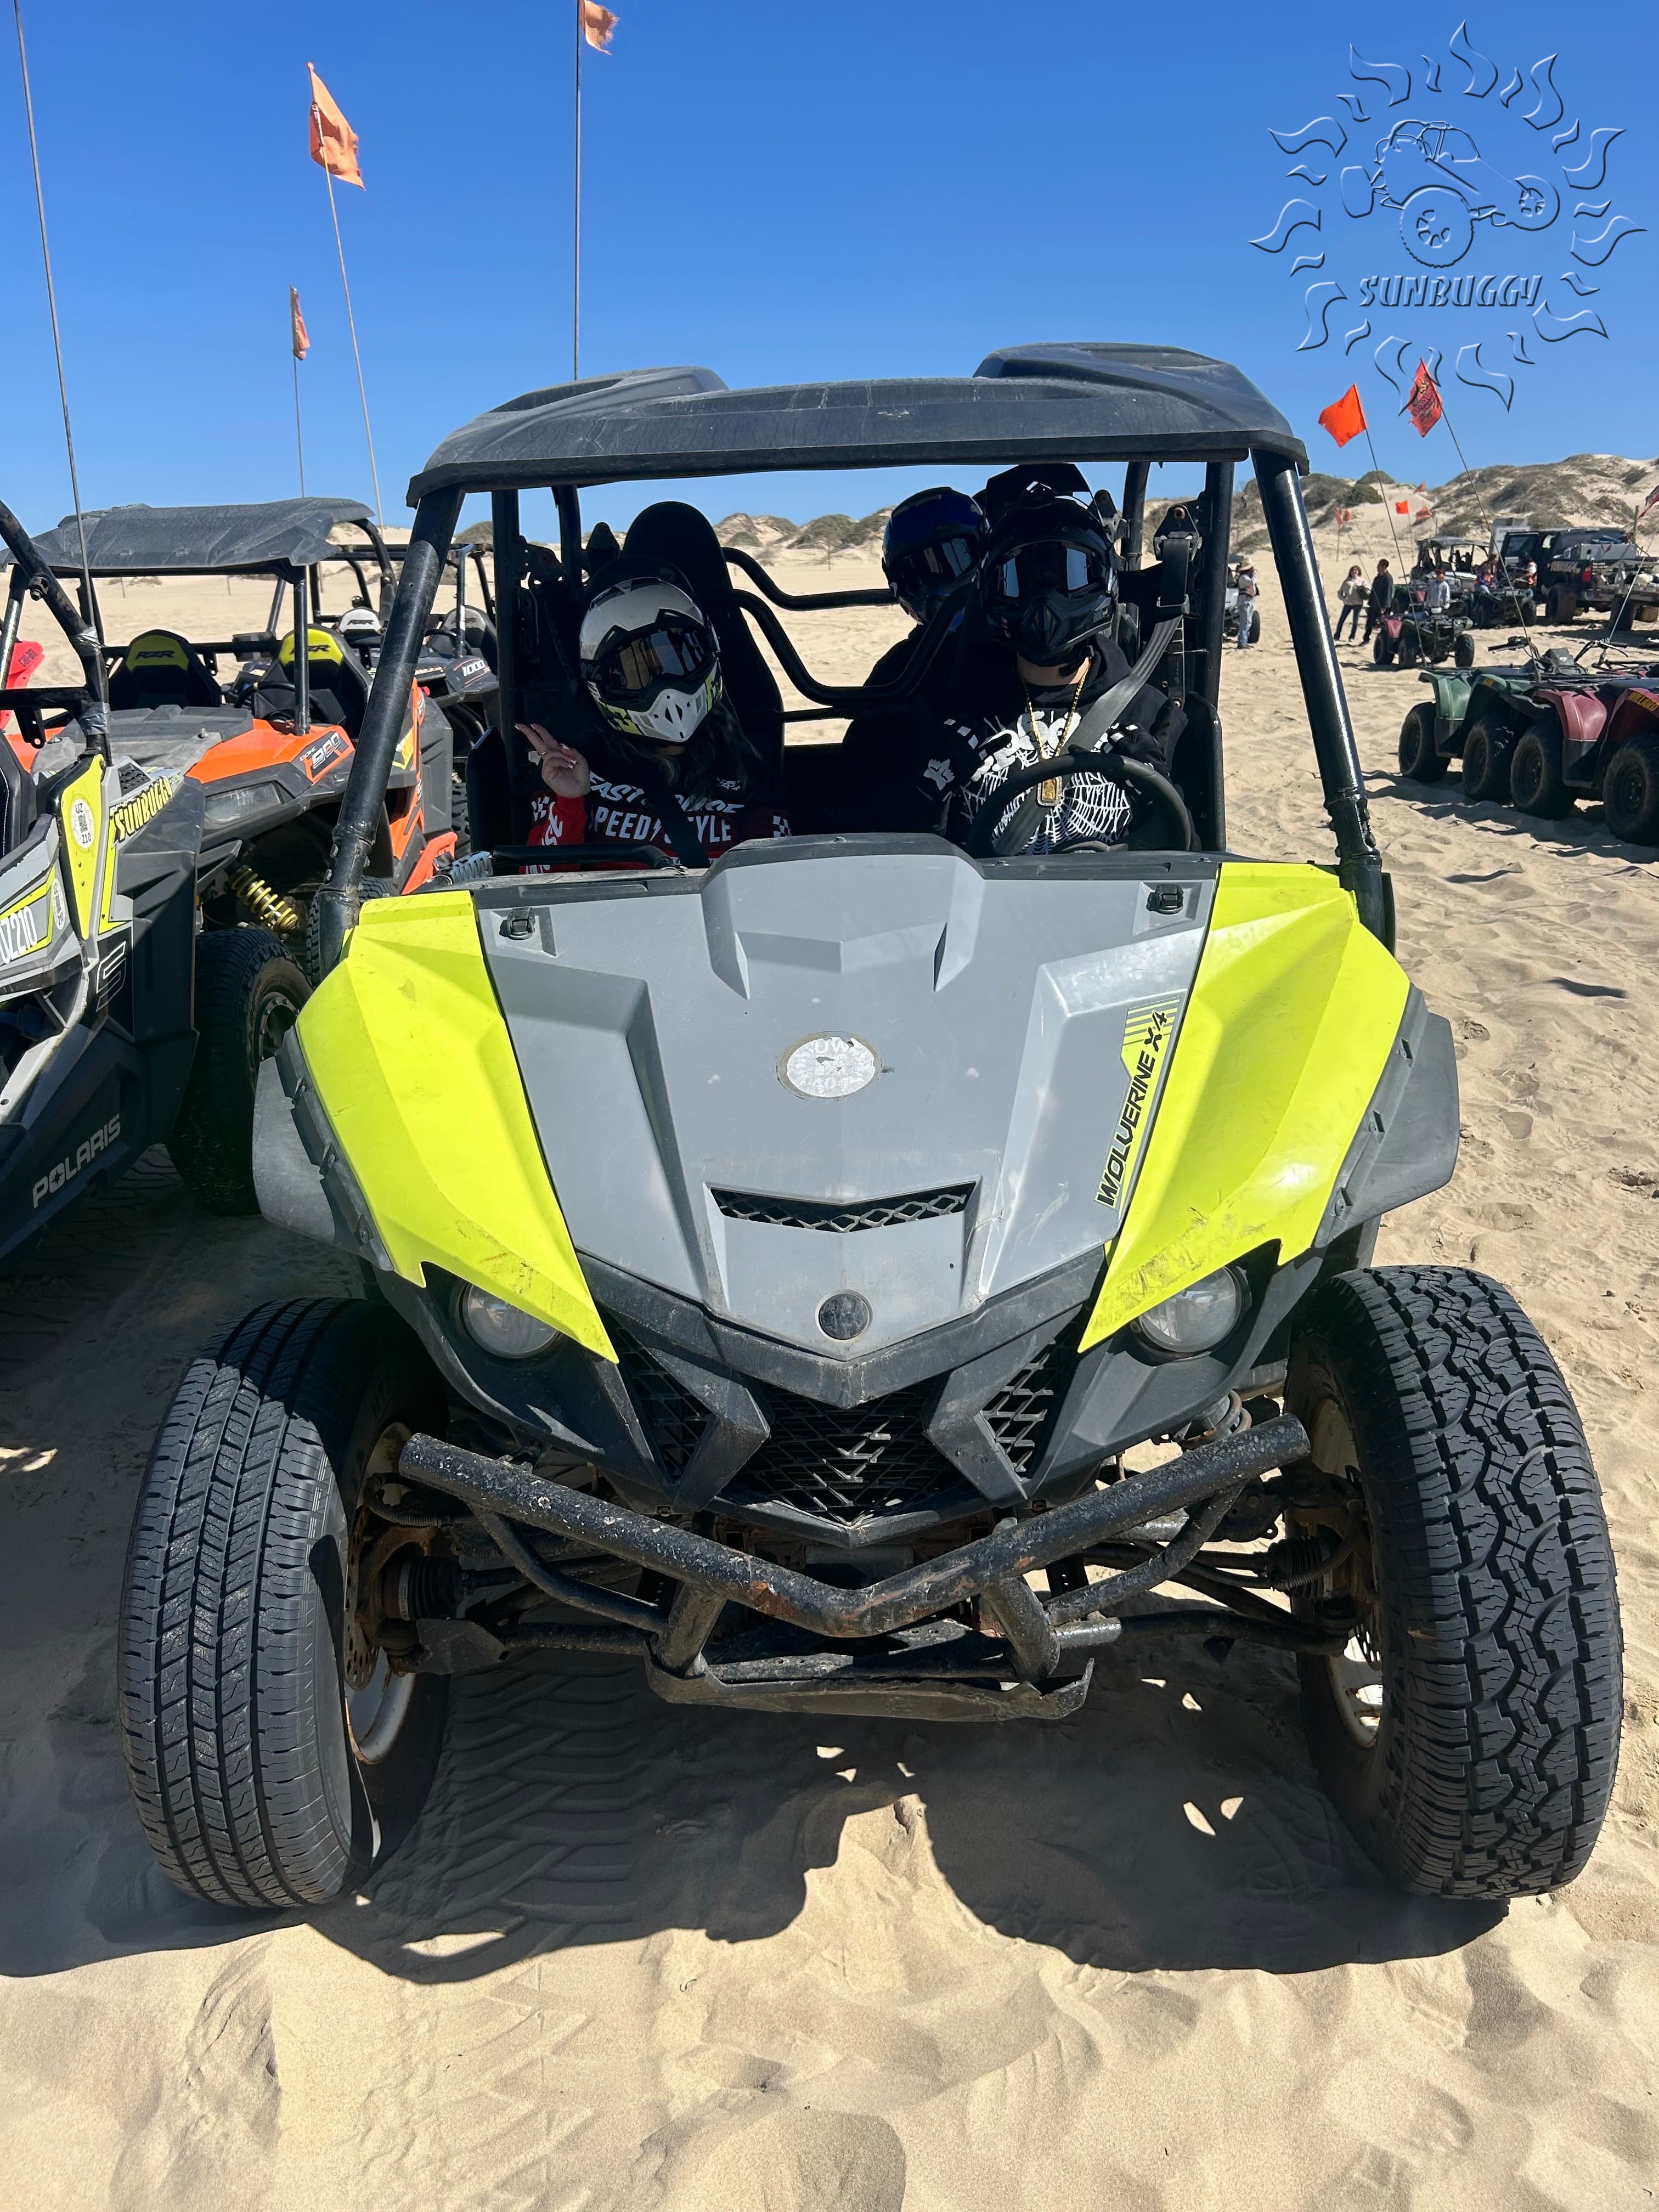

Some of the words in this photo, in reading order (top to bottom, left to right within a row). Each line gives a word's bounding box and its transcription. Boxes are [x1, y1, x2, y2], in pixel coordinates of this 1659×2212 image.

[290, 645, 331, 655] ZR
[462, 659, 486, 676] 1000
[311, 731, 342, 769] 900
[75, 803, 84, 814] UZ
[114, 776, 173, 843] SUNBUGGY
[588, 806, 652, 840] PEED
[82, 832, 91, 844] 210
[1098, 1050, 1155, 1206] WOLVERINE
[1144, 1011, 1167, 1052] X4
[33, 1113, 121, 1209] POLARIS
